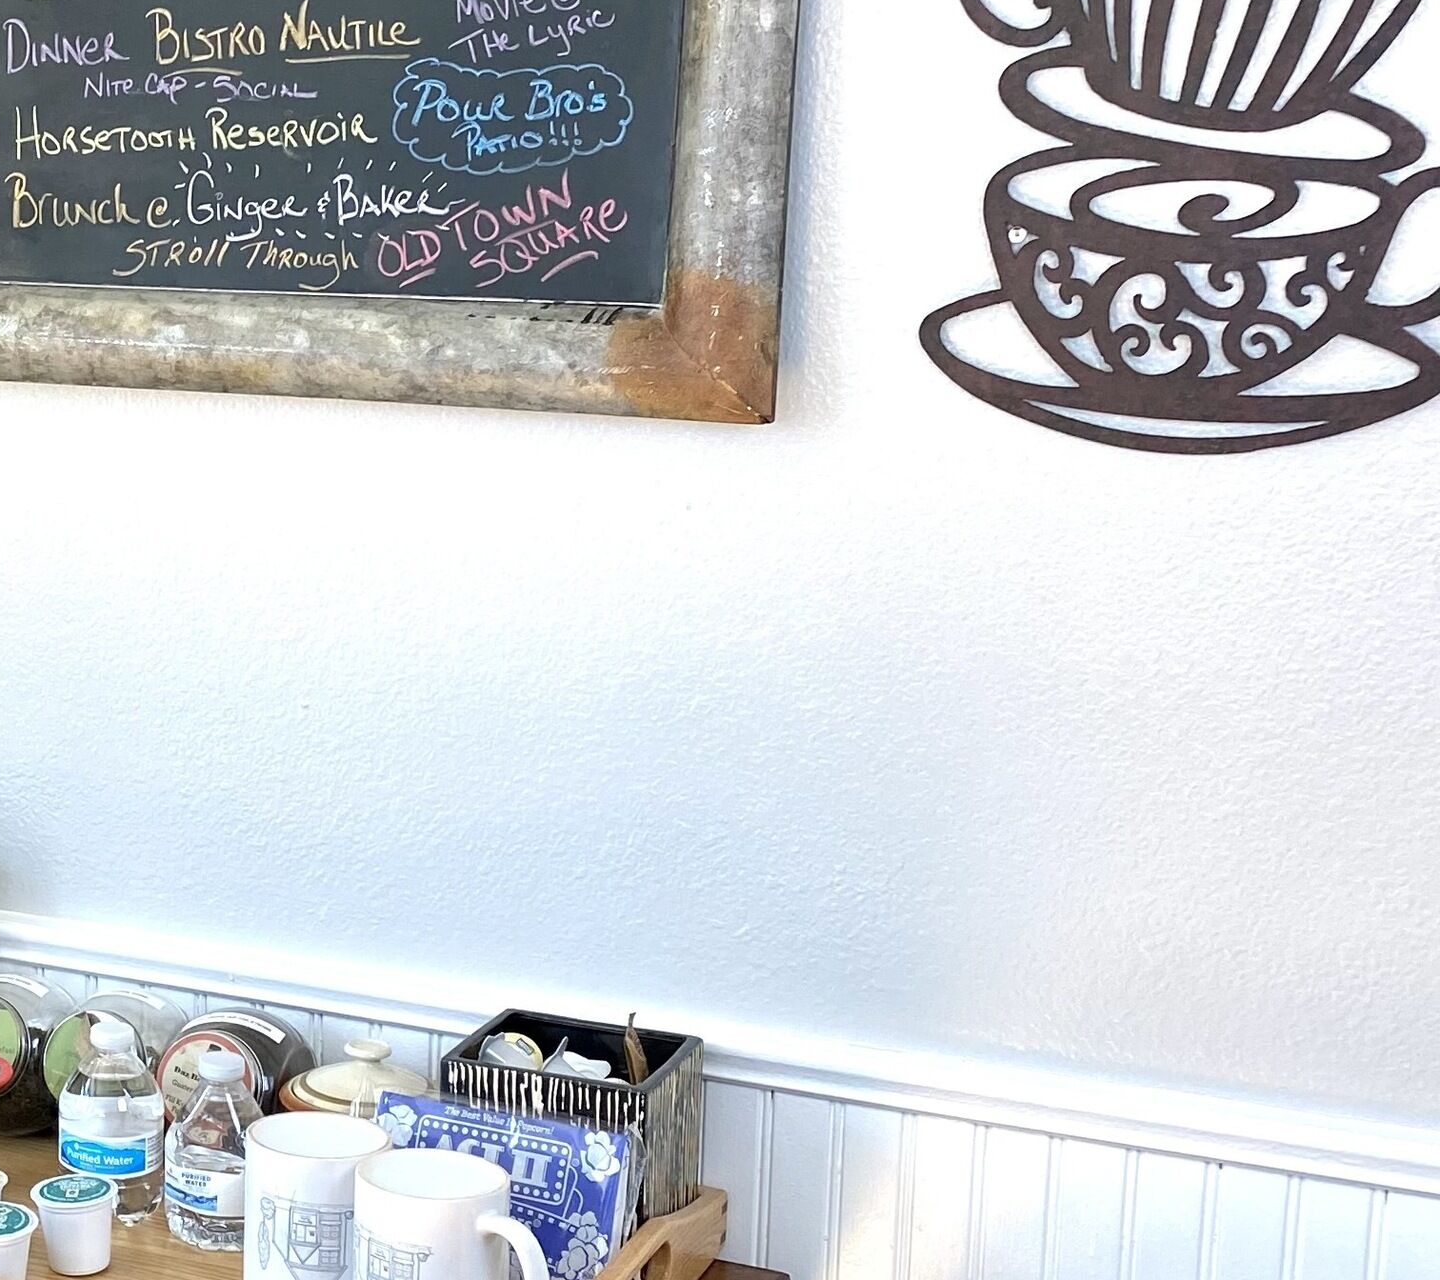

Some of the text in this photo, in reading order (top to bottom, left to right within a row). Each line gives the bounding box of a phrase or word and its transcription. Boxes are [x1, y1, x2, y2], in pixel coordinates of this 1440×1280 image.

[145, 7, 266, 64] BISTRO
[212, 73, 318, 102] SOCIAL
[442, 168, 573, 252] TOWN
[377, 230, 441, 279] OLD
[444, 1106, 460, 1116] The
[461, 1109, 481, 1121] Best
[483, 1113, 505, 1125] Value
[67, 1146, 100, 1164] Purified
[103, 1155, 134, 1165] Water
